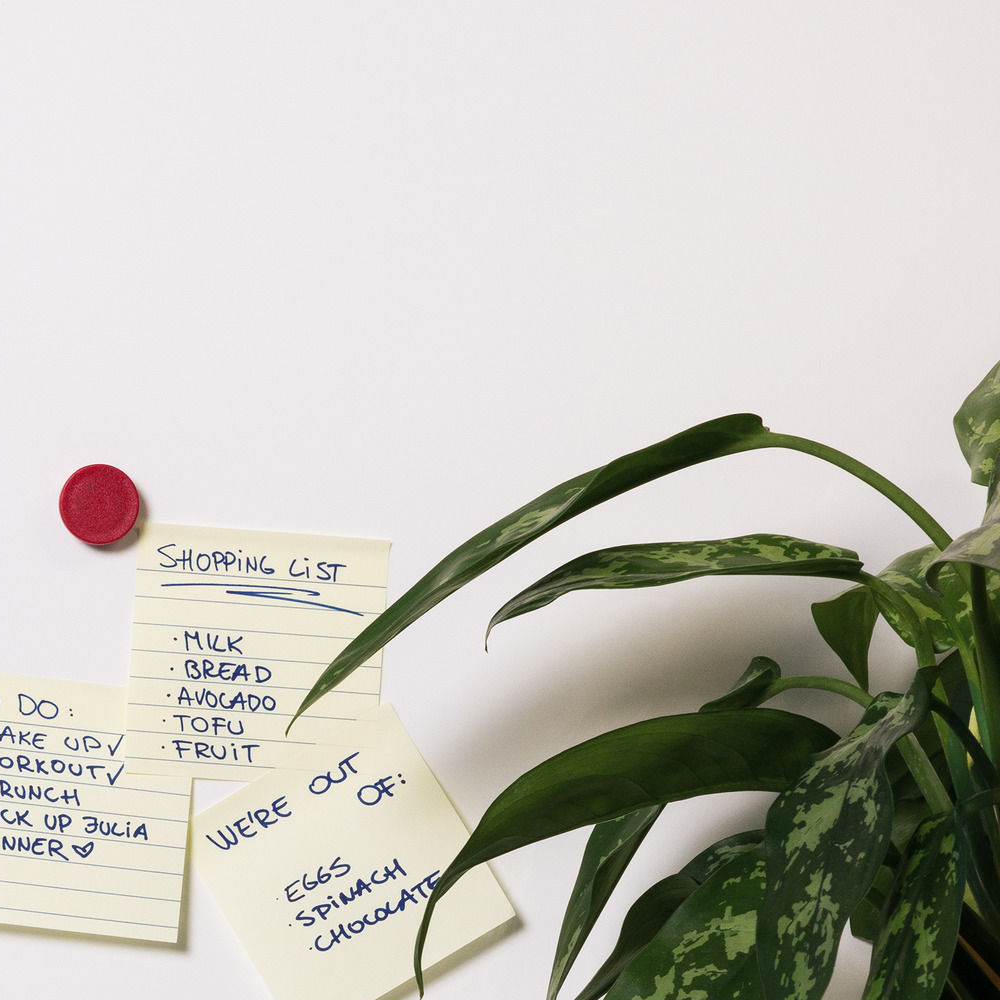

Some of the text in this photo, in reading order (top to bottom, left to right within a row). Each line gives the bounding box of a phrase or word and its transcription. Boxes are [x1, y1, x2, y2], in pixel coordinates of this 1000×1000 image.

[184, 630, 243, 655] MILK
[184, 659, 273, 683] BREAD
[177, 686, 276, 712] AVOCADO
[172, 714, 244, 736] TOFU
[63, 735, 102, 753] UP
[205, 751, 360, 851] WE'RE OUT
[357, 772, 407, 806] OF:
[44, 813, 73, 833] UP
[284, 856, 351, 903] EGGS
